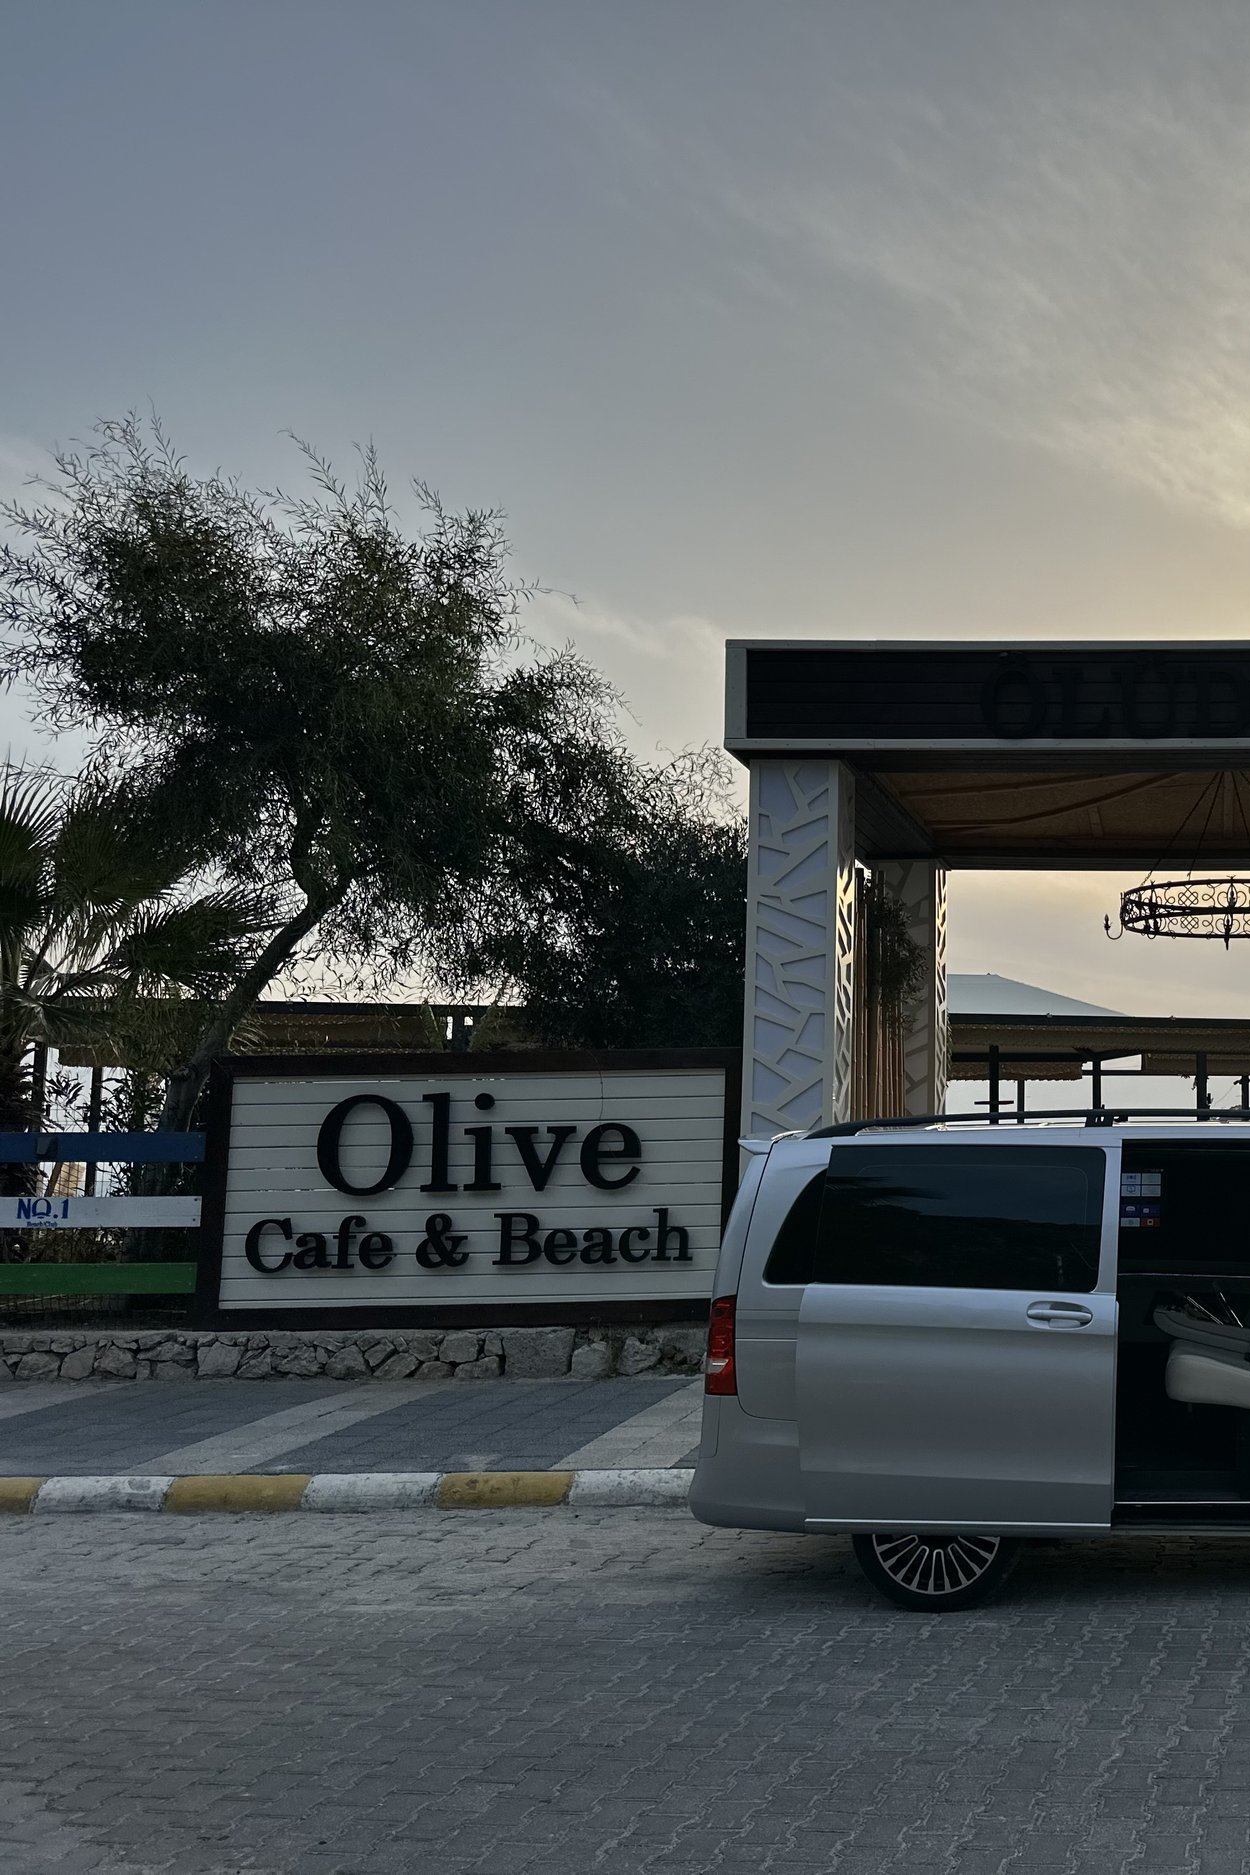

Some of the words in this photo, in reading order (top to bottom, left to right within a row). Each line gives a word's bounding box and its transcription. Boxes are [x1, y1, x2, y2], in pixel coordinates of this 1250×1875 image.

[317, 1092, 643, 1196] Olive
[245, 1214, 395, 1274] Cafe
[415, 1213, 470, 1269] &
[492, 1207, 693, 1267] Beach
